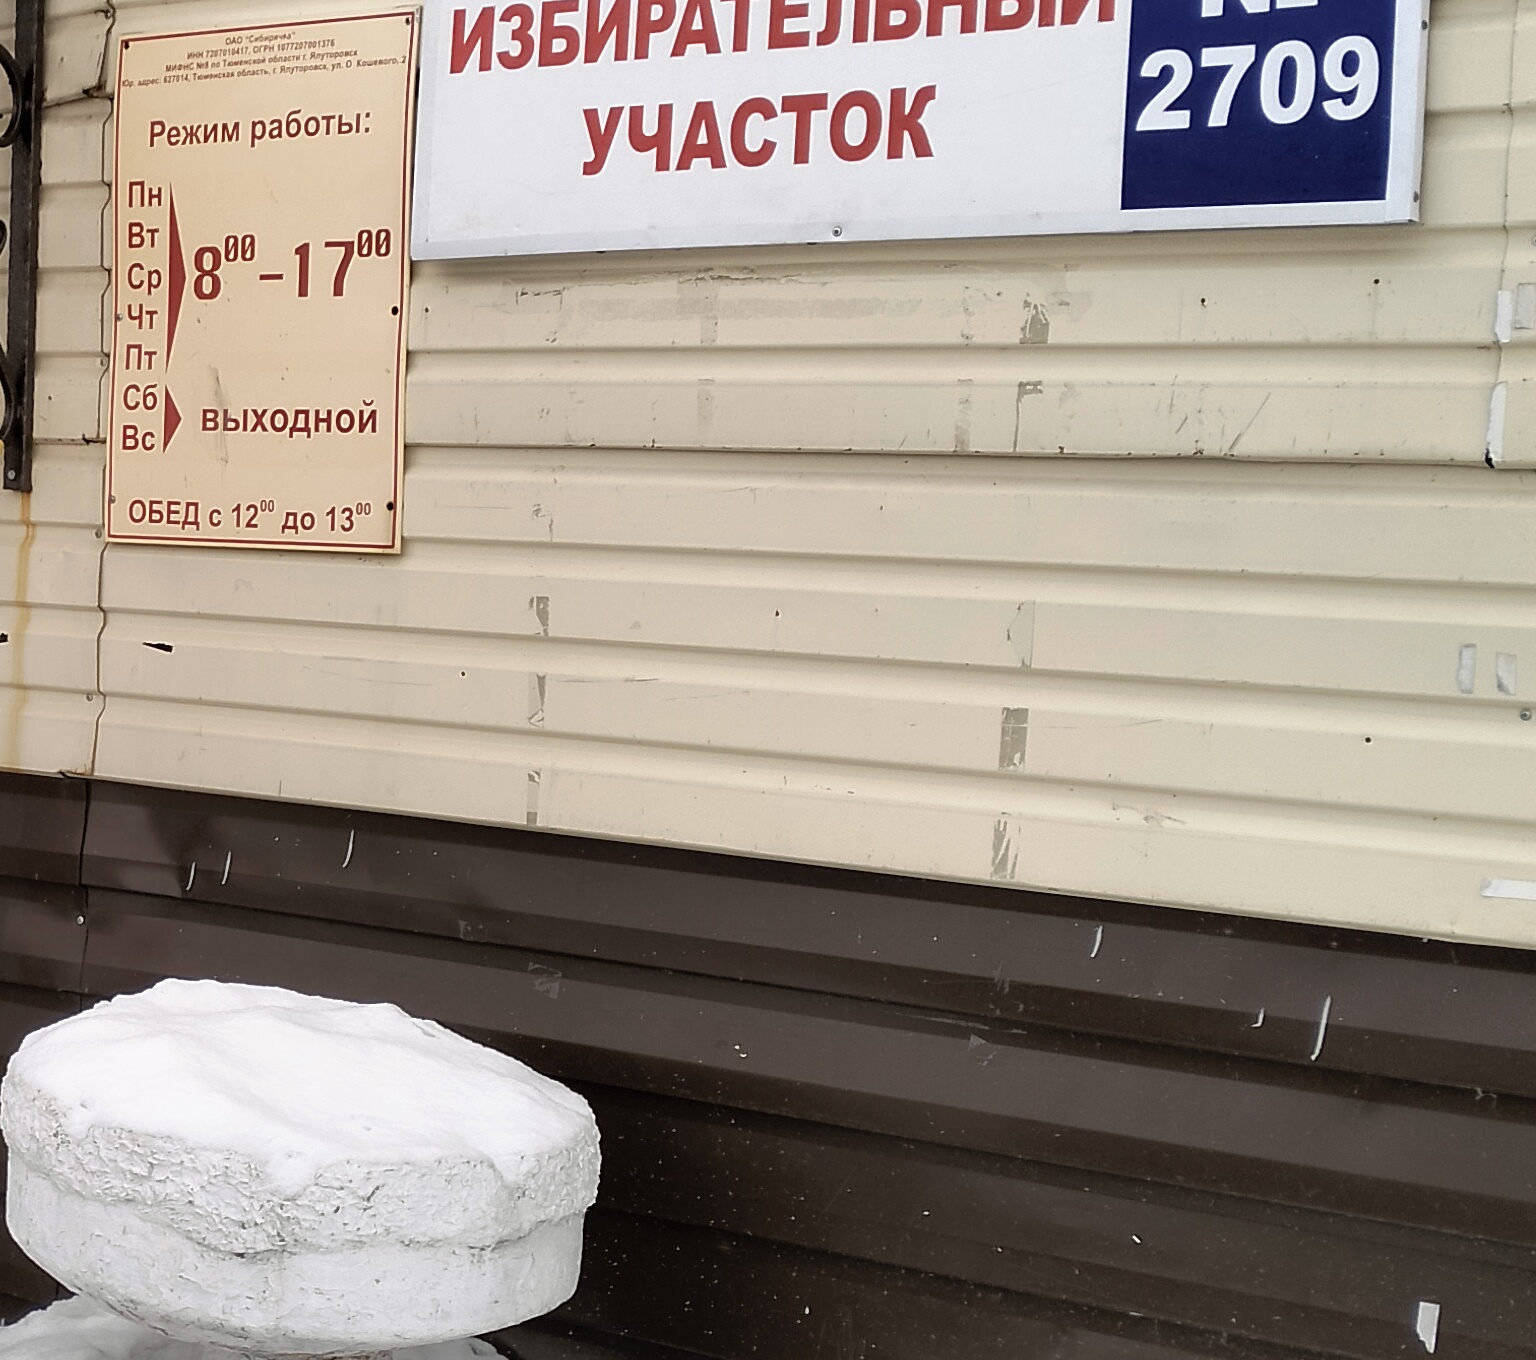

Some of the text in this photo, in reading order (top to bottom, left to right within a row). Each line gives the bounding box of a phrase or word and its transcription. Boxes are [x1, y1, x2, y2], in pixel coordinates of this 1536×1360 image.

[186, 51, 204, 60] ИНН
[252, 44, 275, 54] ОГРН
[224, 36, 243, 45] ОАО
[165, 62, 195, 72] МИФНС
[222, 56, 267, 68] Тюменской
[268, 53, 301, 63] области
[309, 49, 359, 61] Ялуторовск
[192, 69, 235, 81] Тюменская
[1134, 34, 1381, 133] 2709
[149, 108, 372, 148] Режим работы:
[581, 86, 936, 176] УЧАСТОК
[128, 180, 163, 209] Пн
[128, 221, 160, 249] Вт
[127, 262, 162, 296] Ср
[127, 303, 159, 330] Чт
[125, 343, 158, 371] Пт
[123, 383, 158, 411] Сб
[201, 399, 378, 439] выходной
[121, 424, 156, 452] Вс
[128, 499, 200, 532] ОБЕД
[208, 508, 223, 528] с
[281, 511, 316, 535] до
